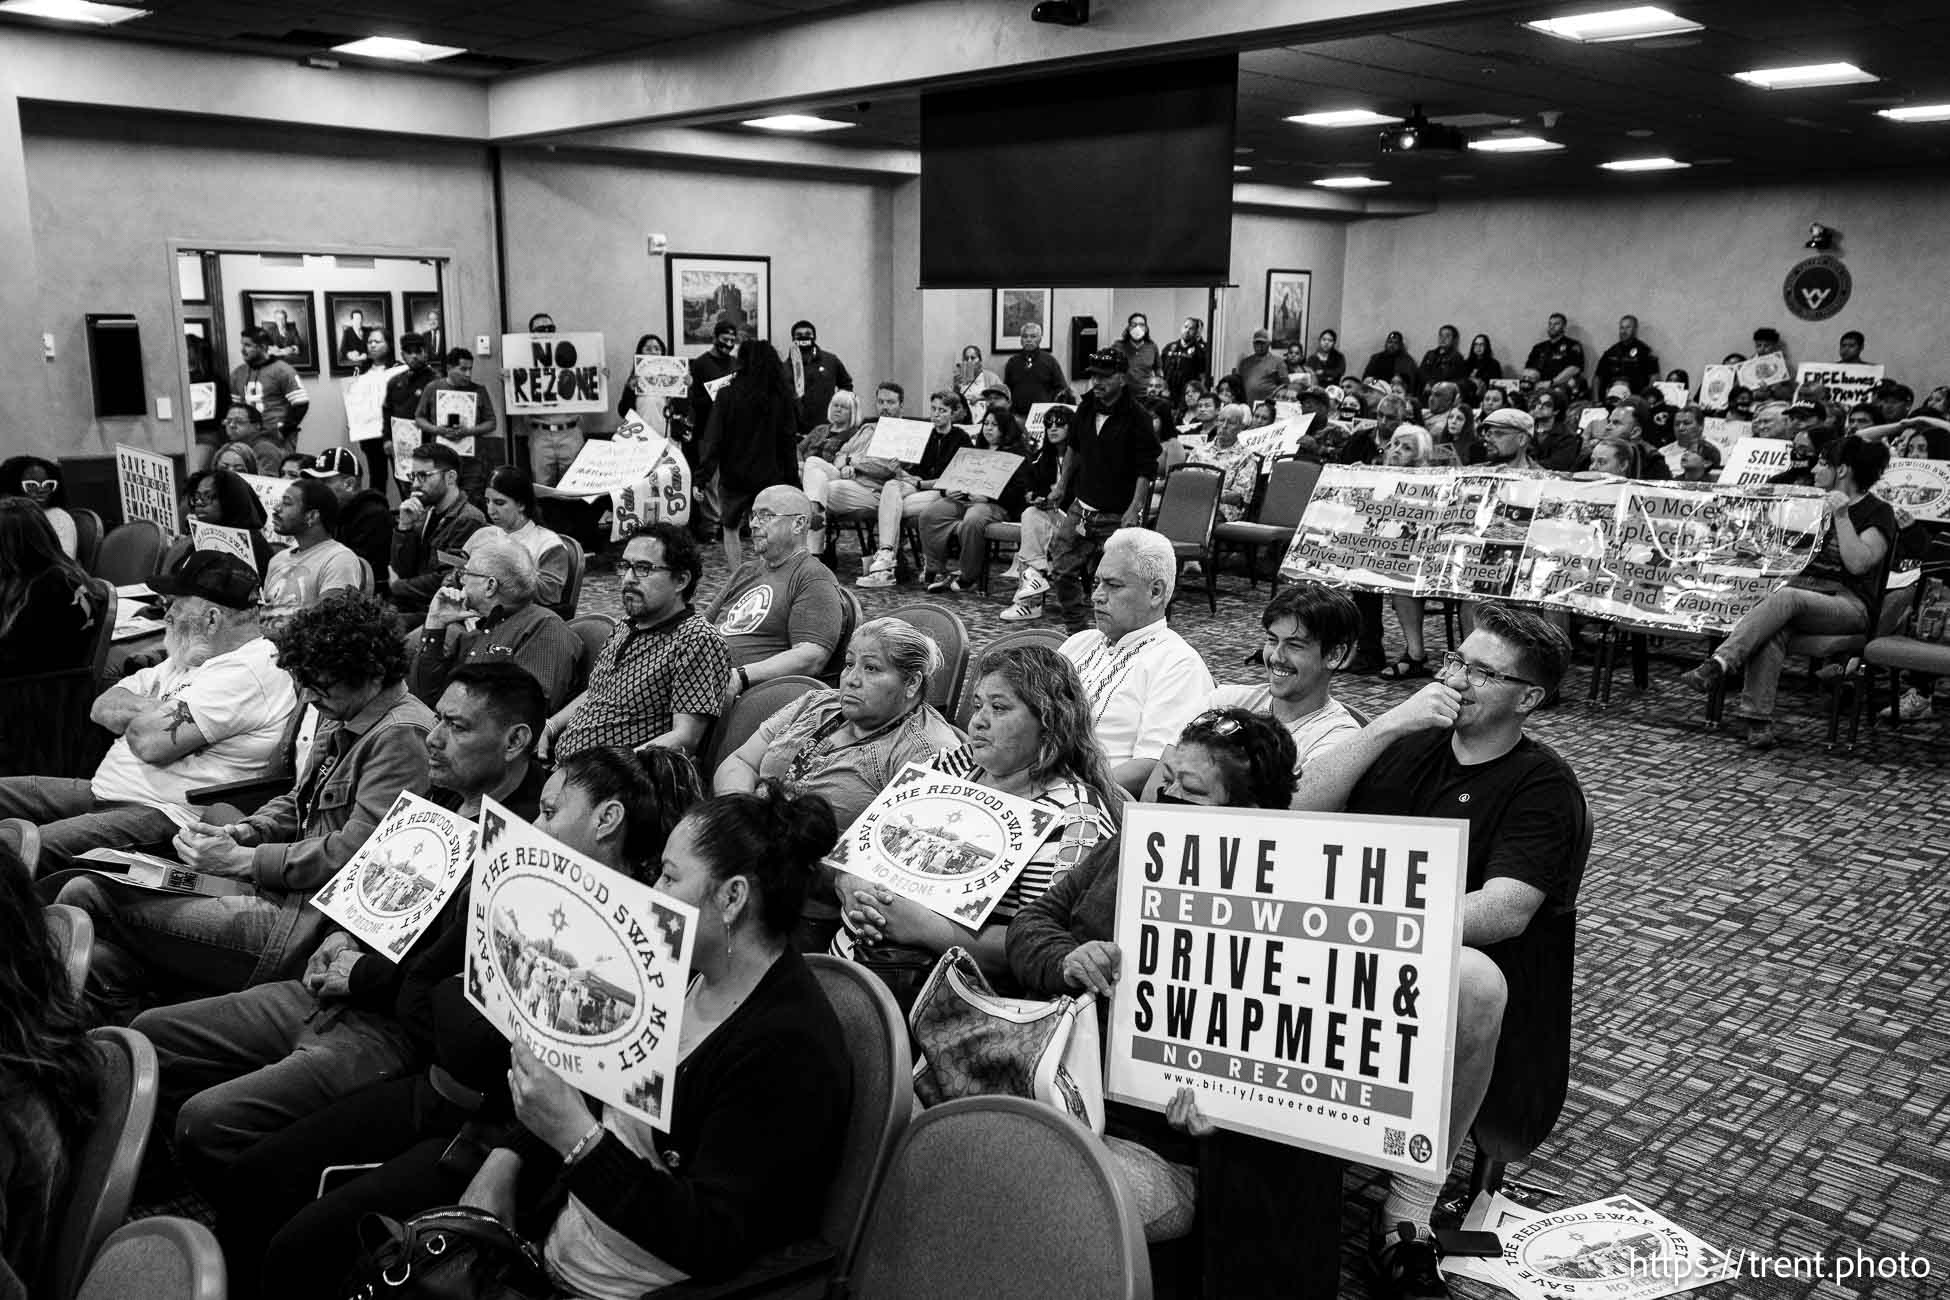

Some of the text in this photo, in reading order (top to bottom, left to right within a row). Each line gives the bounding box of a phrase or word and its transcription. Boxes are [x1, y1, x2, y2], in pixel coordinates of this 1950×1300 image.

[532, 341, 577, 368] NO
[512, 367, 599, 403] REZONE
[121, 453, 169, 482] SAVE THE
[1748, 449, 1788, 465] SAVE
[1394, 481, 1417, 498] No
[1627, 494, 1656, 513] No
[1661, 497, 1716, 519] More
[1299, 542, 1356, 565] Drive-in
[1360, 553, 1414, 573] Theater
[1331, 532, 1397, 551] Salvemos
[1402, 537, 1415, 552] El
[1622, 587, 1657, 605] and
[859, 784, 1023, 895] SAVE THE REDWOOD SWAP MEET
[343, 811, 461, 930] SAVE THE REDWOOD SWAP MEET
[1145, 831, 1429, 910] SAVE THE
[1144, 890, 1422, 949] REDWOOD
[476, 846, 668, 1073] SAVE THE REDWOOD SWAP MEET
[1134, 980, 1419, 1085] SWAPMEET
[1163, 1043, 1373, 1107] NO REZONE
[1163, 1071, 1372, 1126] www.bit.ly/saveredwood
[1504, 1210, 1690, 1293] SAVE THE REDWOOD SWAP MEET
